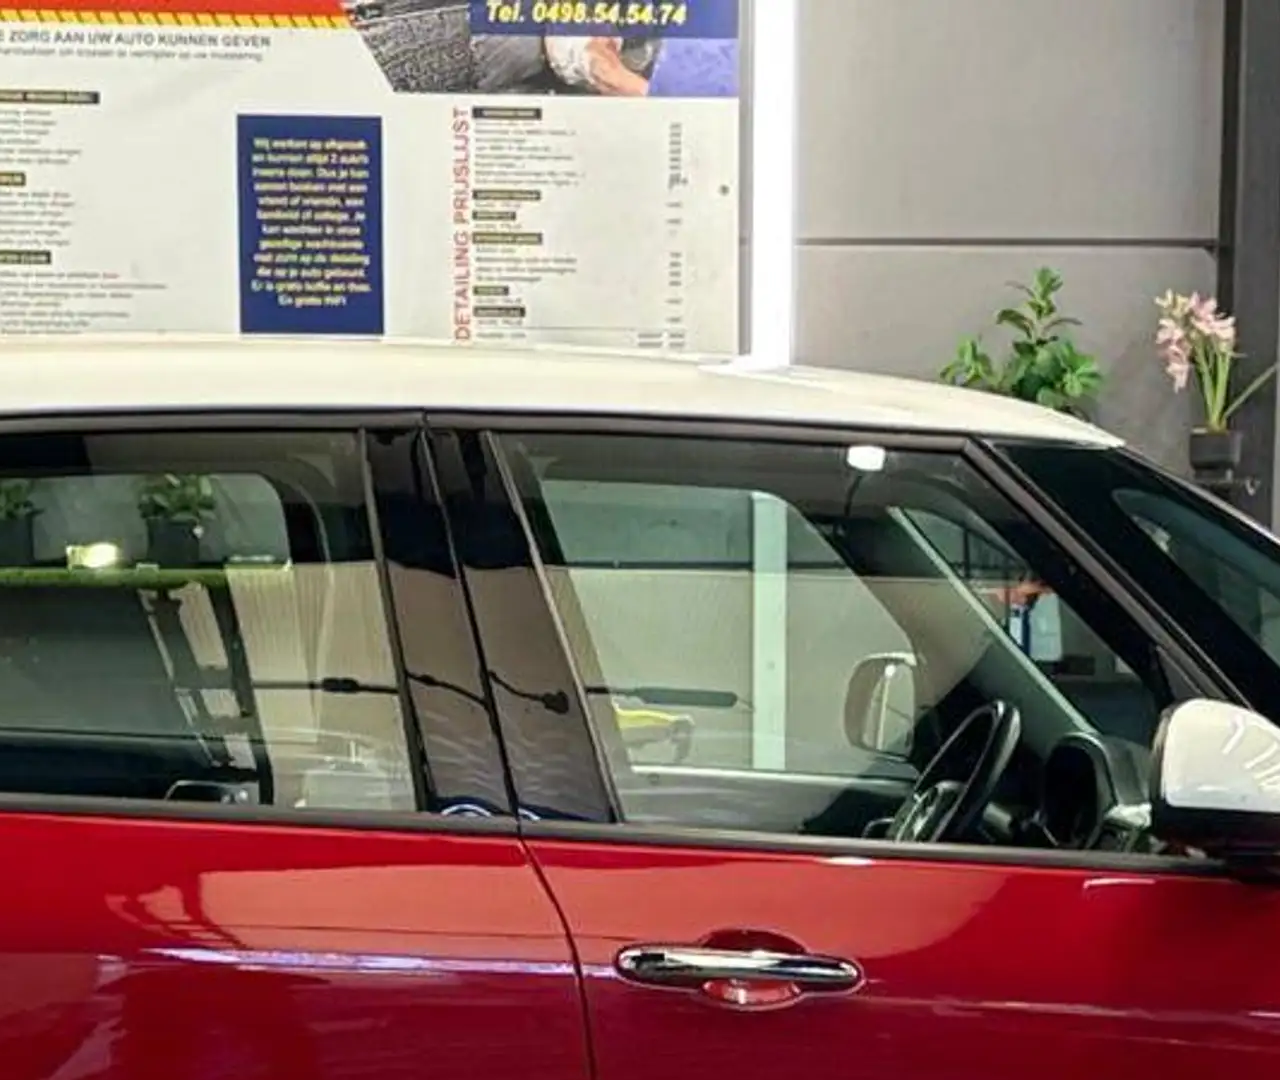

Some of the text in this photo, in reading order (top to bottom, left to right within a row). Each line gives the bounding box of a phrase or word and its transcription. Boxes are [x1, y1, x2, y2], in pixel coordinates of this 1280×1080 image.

[487, 1, 687, 25] Tel. 0498.54.54.74
[8, 29, 50, 43] ZORG
[53, 30, 84, 44] AAN
[87, 31, 113, 45] UW
[114, 31, 154, 46] AUTO
[157, 33, 219, 47] KUNNEN
[222, 34, 271, 48] GEVEN
[453, 105, 471, 340] DETAILING PRIJSLIJST
